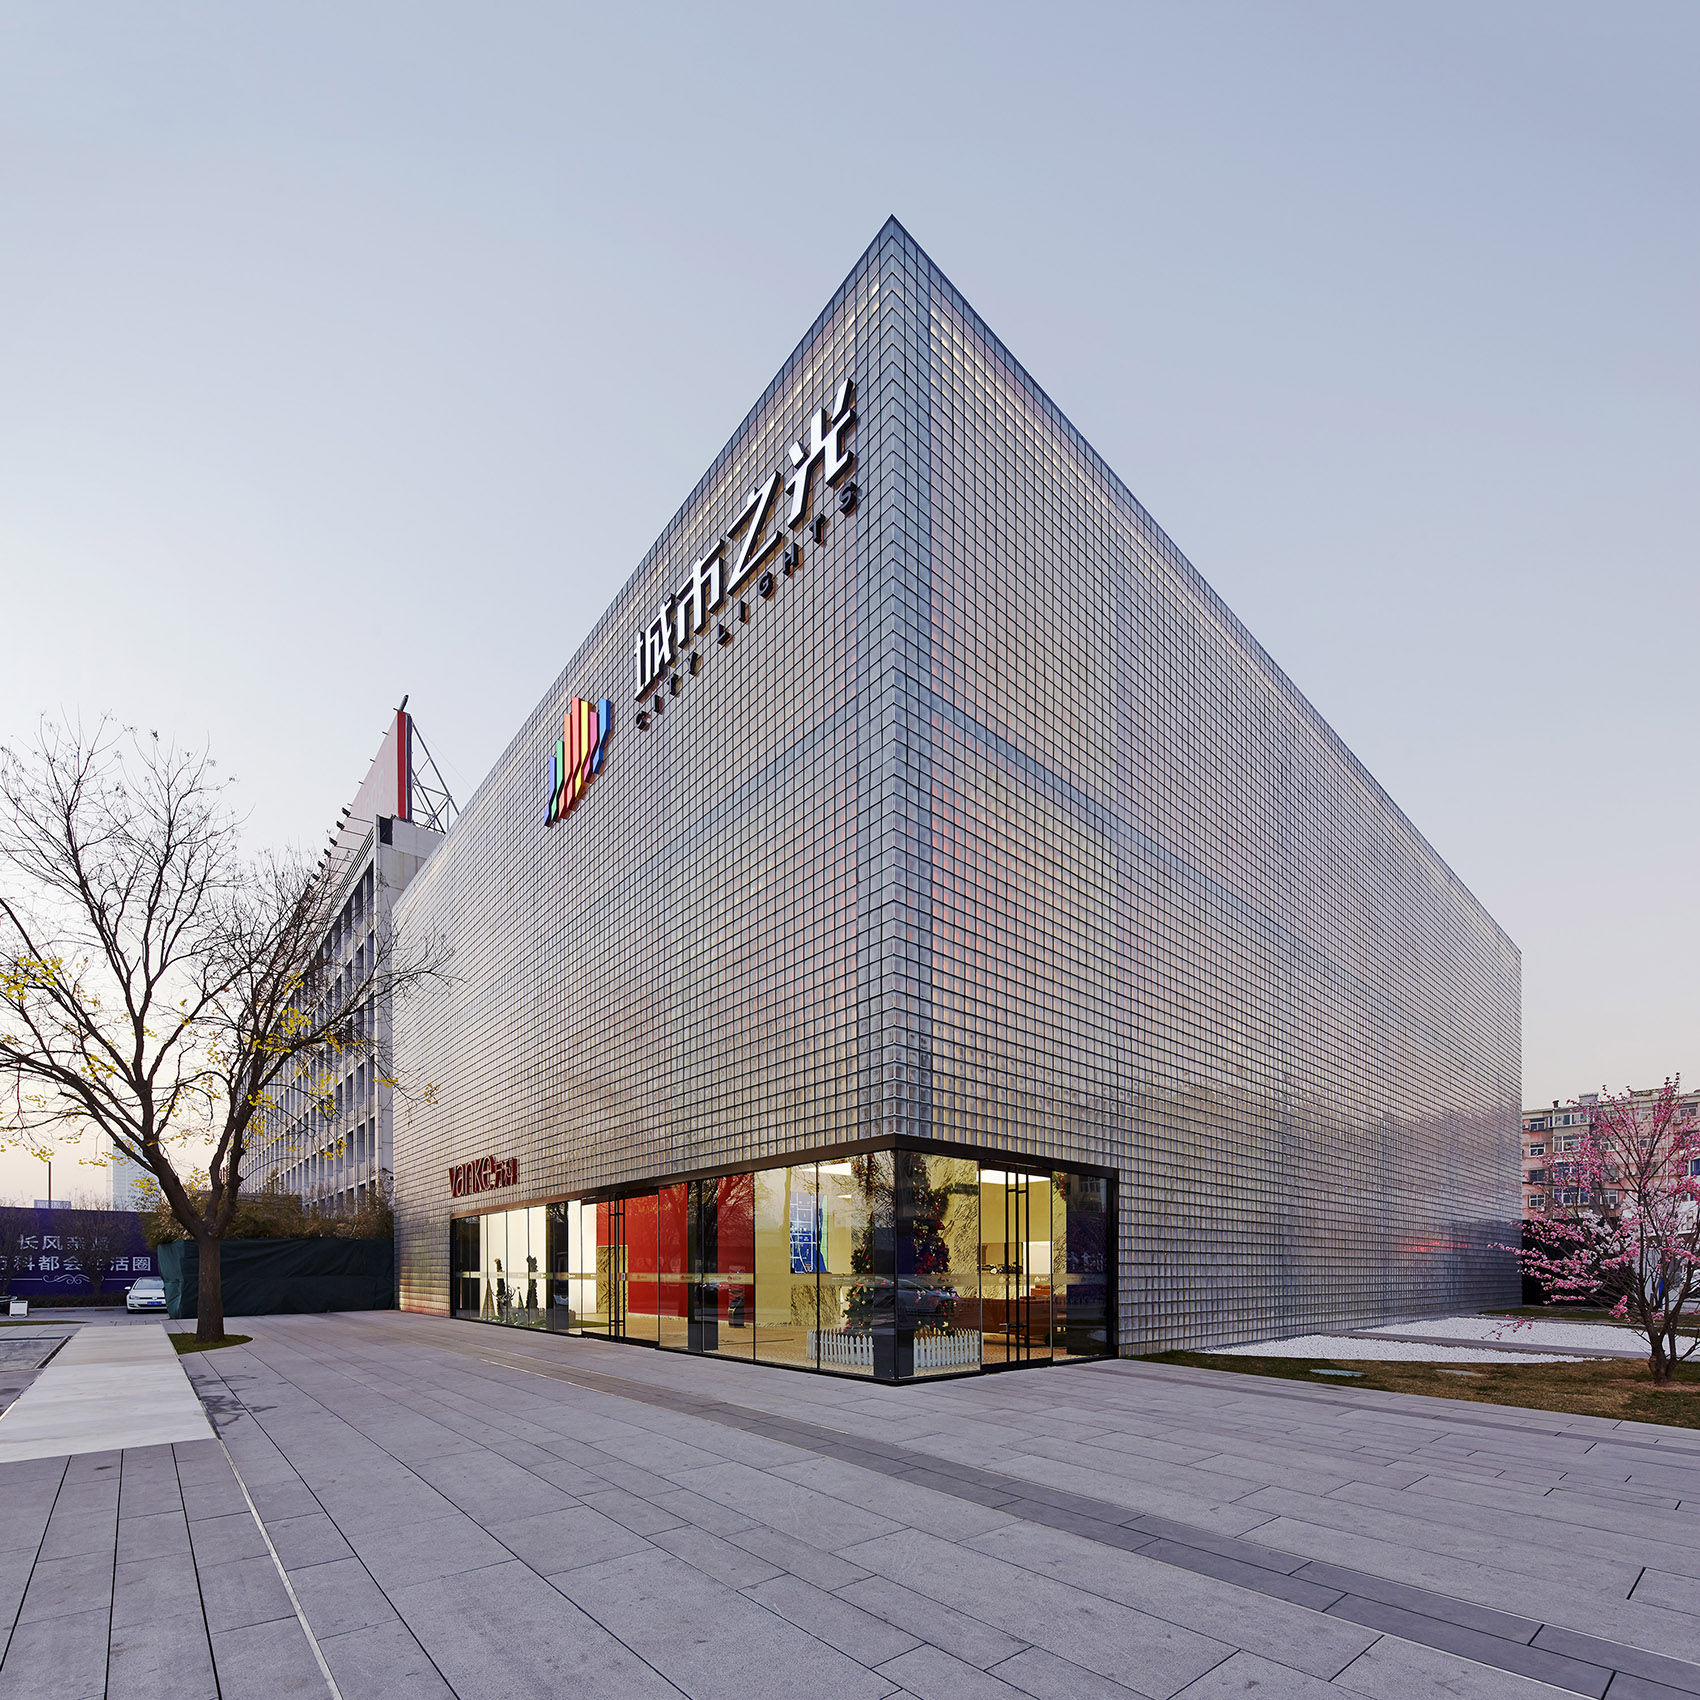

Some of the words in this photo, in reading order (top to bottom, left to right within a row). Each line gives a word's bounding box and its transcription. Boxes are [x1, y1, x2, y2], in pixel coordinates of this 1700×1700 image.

[634, 377, 857, 702] 城市之光
[635, 651, 700, 731] CITY
[717, 480, 859, 647] LIGHTS
[0, 1255, 151, 1271] 科都会活圈
